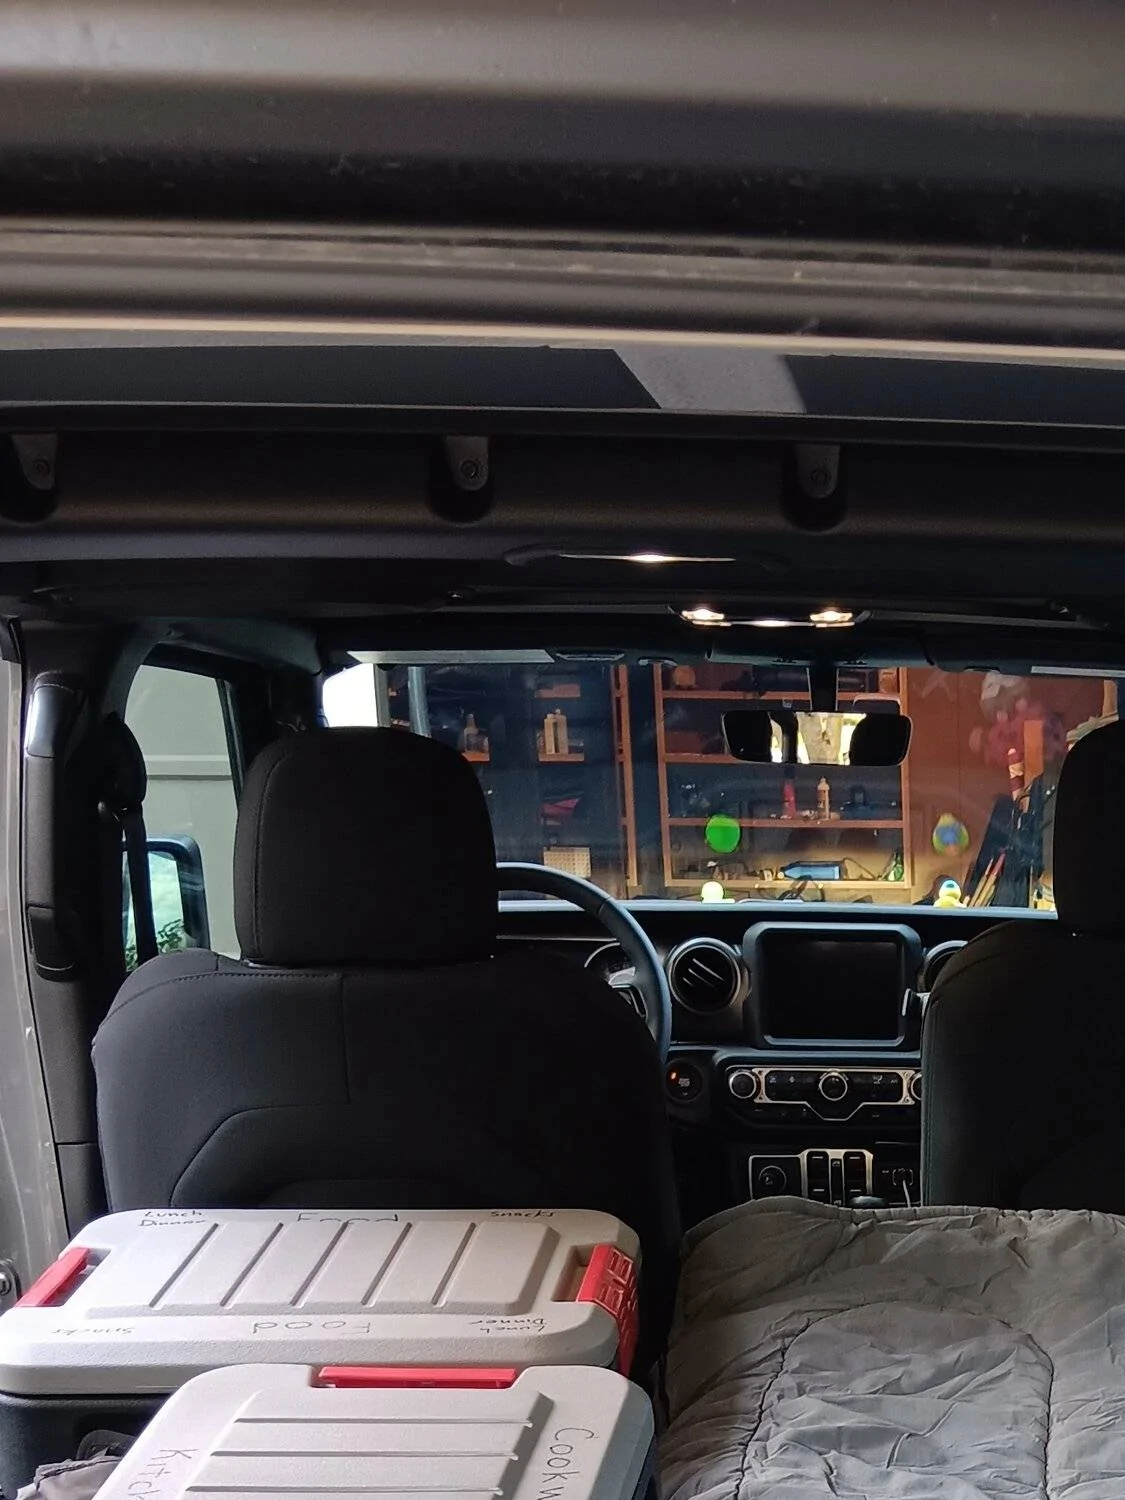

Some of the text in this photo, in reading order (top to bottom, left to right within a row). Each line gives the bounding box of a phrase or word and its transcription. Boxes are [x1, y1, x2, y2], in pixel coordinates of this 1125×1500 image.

[144, 1210, 203, 1218] Lunch
[490, 1210, 556, 1218] Snacks
[252, 1320, 371, 1335] Food
